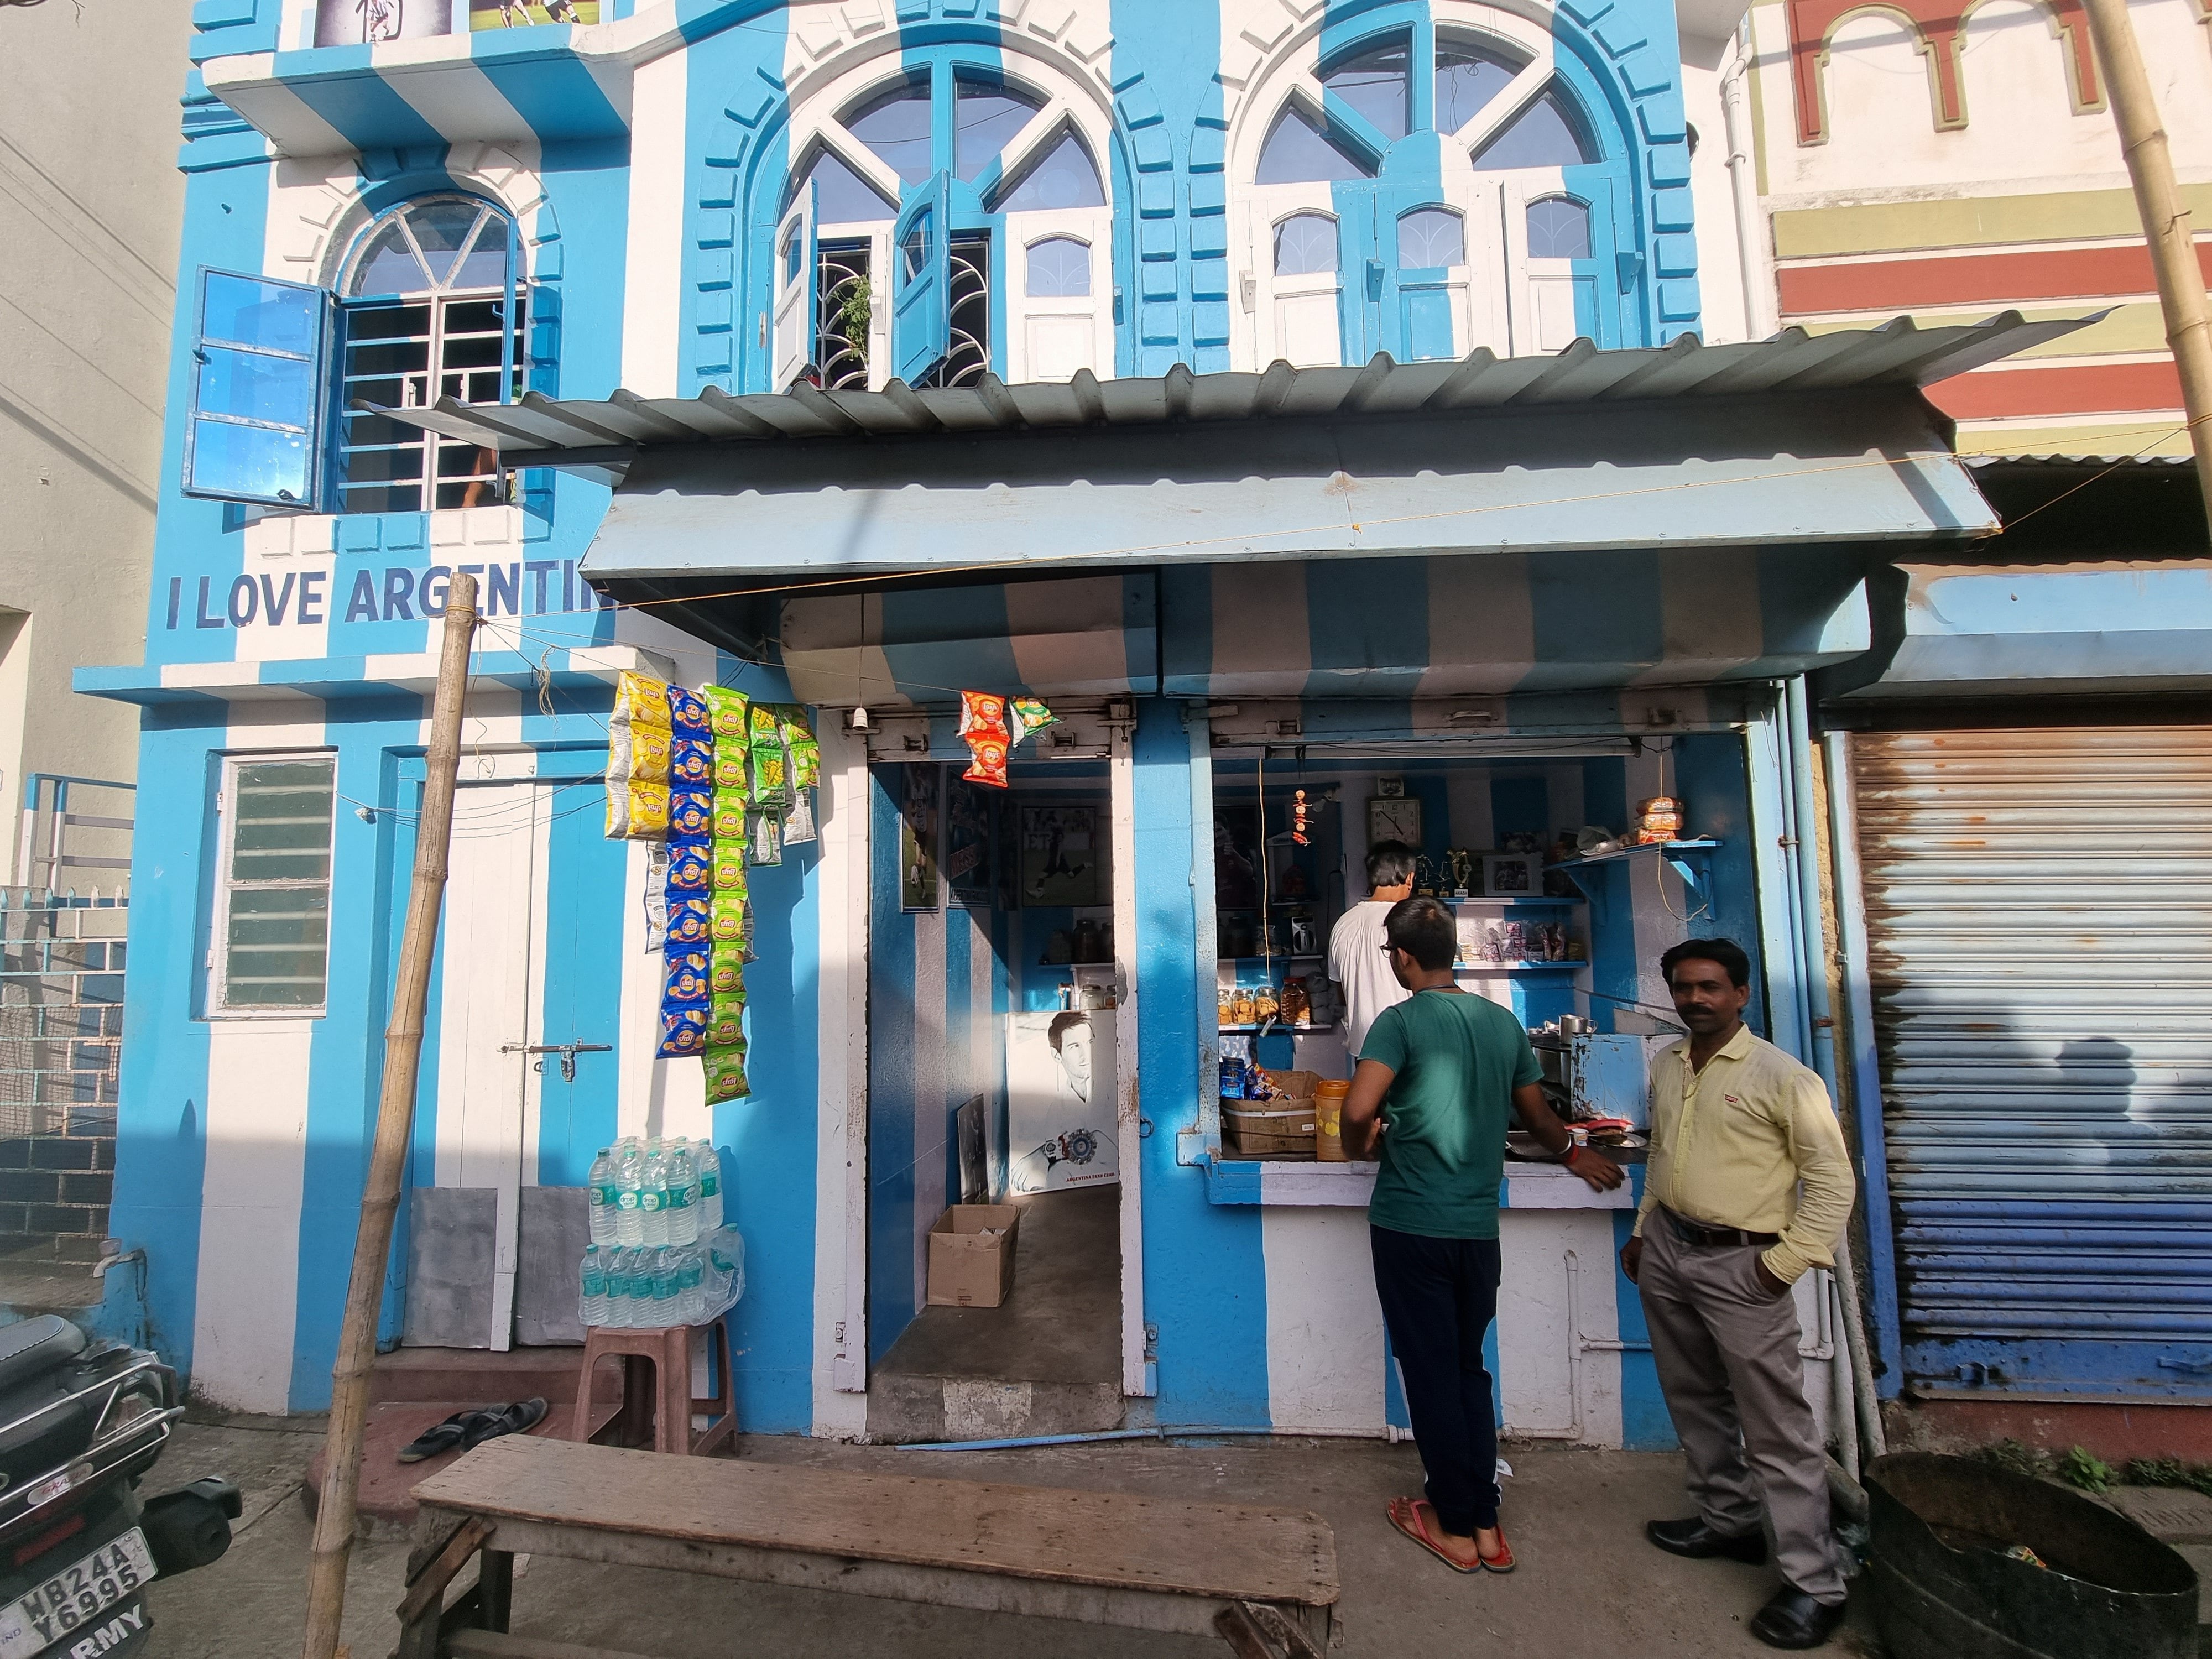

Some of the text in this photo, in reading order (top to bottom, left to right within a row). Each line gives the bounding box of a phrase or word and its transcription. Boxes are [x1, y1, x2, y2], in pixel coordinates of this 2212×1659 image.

[166, 559, 630, 630] I LOVE ARGNTI
[20, 1543, 130, 1623] WB24A
[32, 1564, 139, 1644] Y6995
[57, 1603, 144, 1659] RMY
